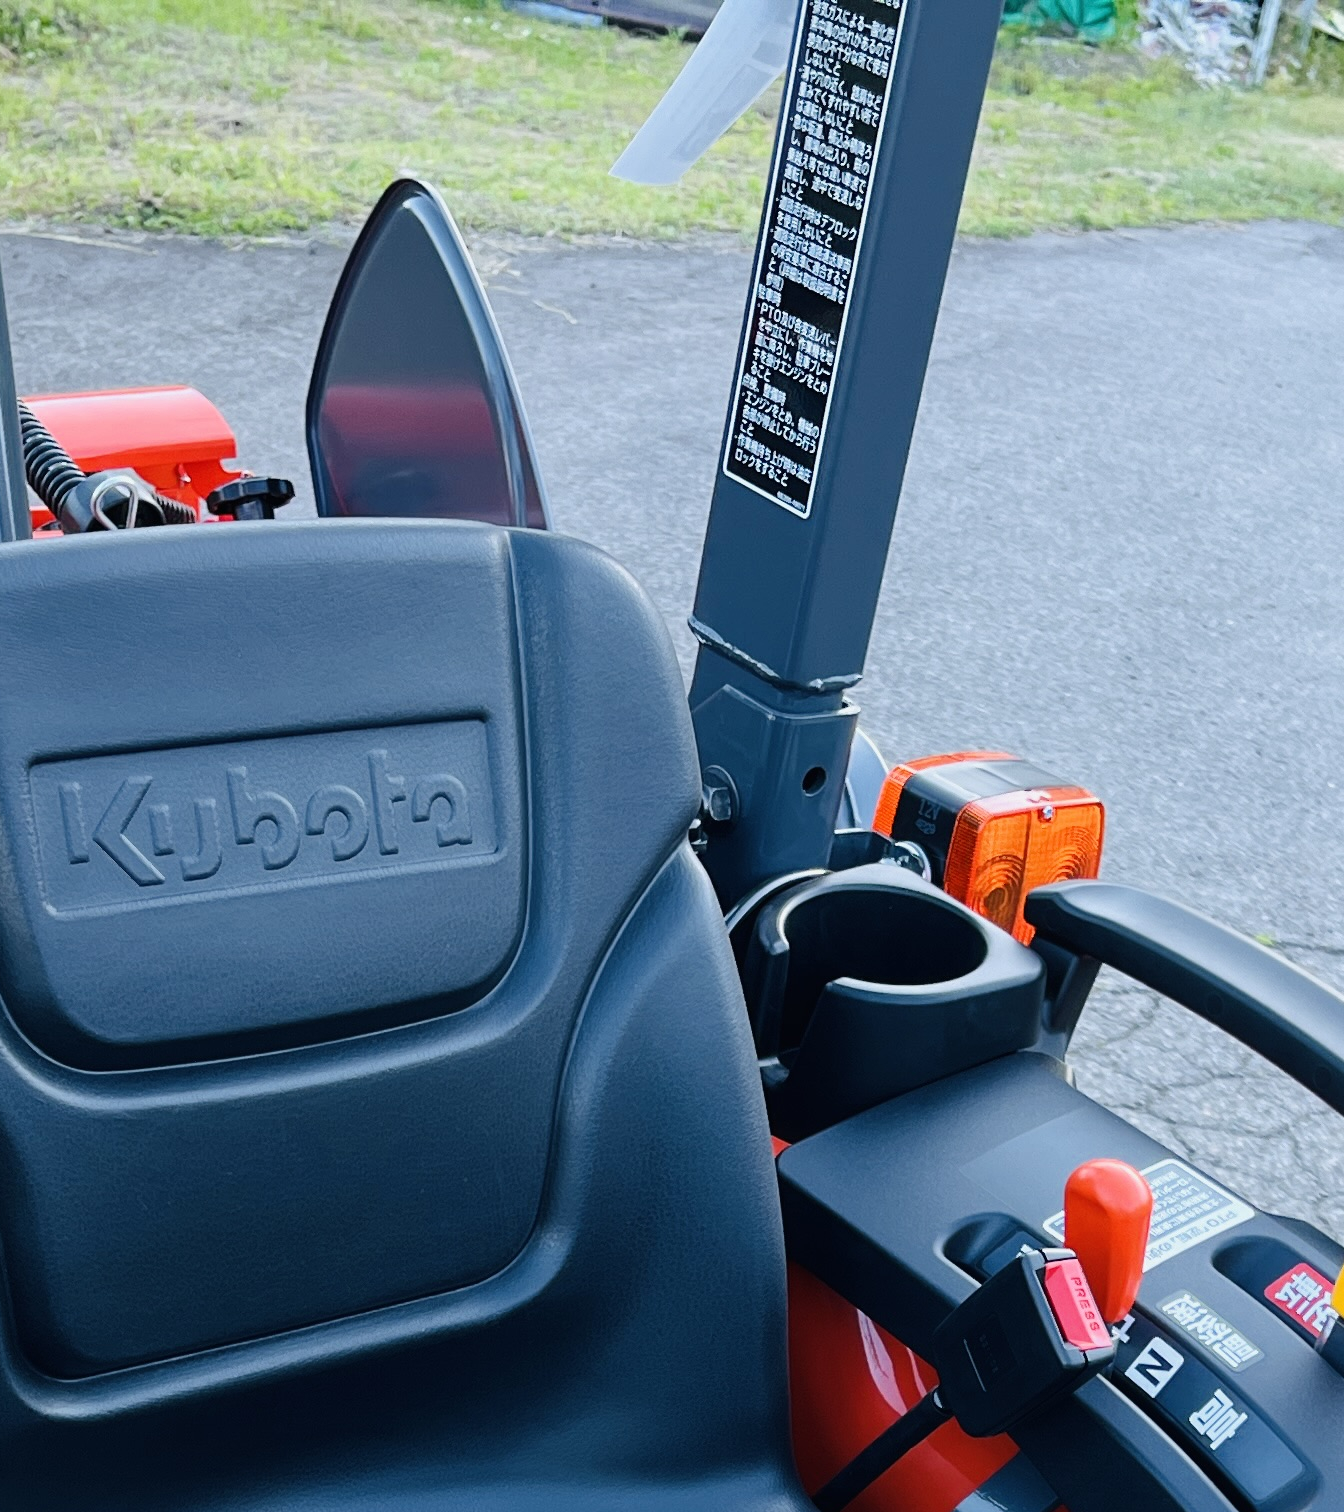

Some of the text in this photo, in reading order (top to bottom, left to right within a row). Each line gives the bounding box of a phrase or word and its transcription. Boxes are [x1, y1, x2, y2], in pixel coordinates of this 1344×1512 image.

[58, 749, 472, 887] Kubota
[1071, 1277, 1100, 1331] PRESS
[1162, 1293, 1258, 1368] 副変速
[1134, 1347, 1174, 1388] N
[1188, 1388, 1249, 1450] 高
